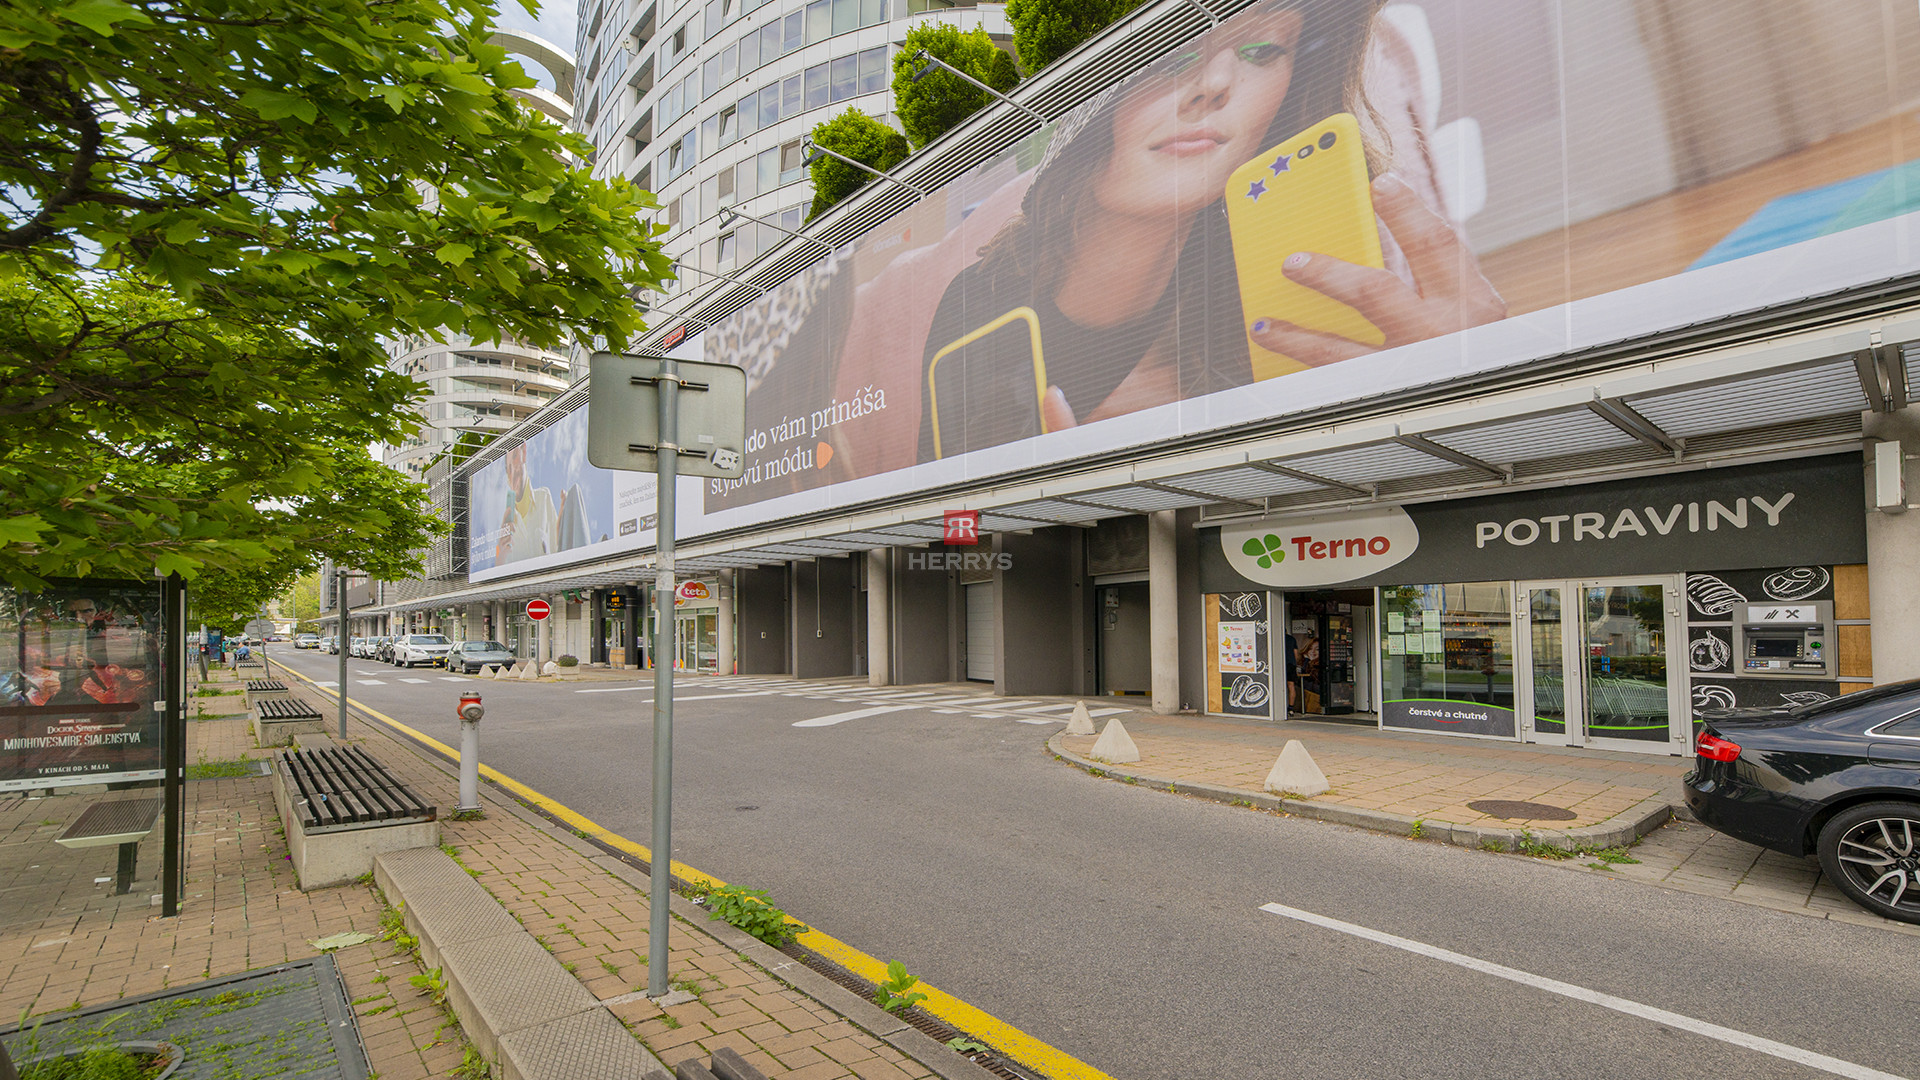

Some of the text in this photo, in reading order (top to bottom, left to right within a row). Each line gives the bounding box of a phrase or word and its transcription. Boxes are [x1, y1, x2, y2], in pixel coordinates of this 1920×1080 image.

[770, 415, 808, 446] vám
[811, 383, 888, 439] prináša
[764, 446, 813, 480] módu
[1475, 492, 1796, 549] POTRAVINY
[1290, 535, 1391, 562] Terno
[684, 587, 707, 596] teta
[1408, 707, 1443, 718] čerstvé
[1452, 711, 1488, 721] chutné
